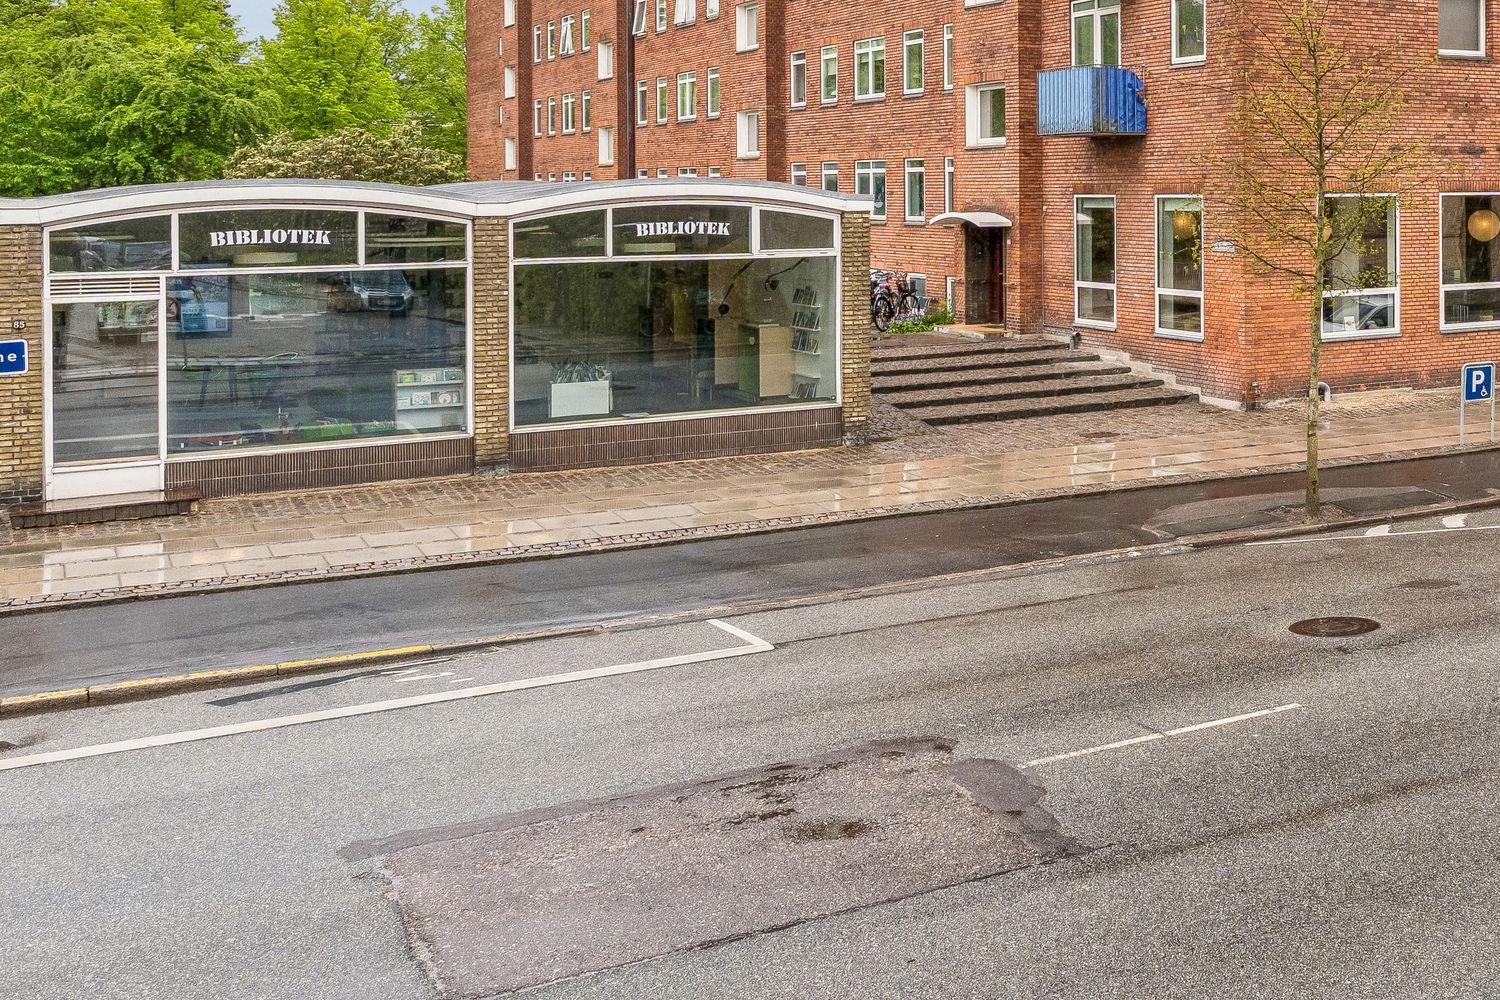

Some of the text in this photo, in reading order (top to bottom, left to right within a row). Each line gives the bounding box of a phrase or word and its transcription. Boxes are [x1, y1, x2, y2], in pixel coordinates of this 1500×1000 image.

[636, 221, 730, 237] BIBLIOTEK
[209, 229, 331, 247] BIBLIOTEK
[13, 320, 26, 329] 85
[1472, 370, 1485, 393] P
